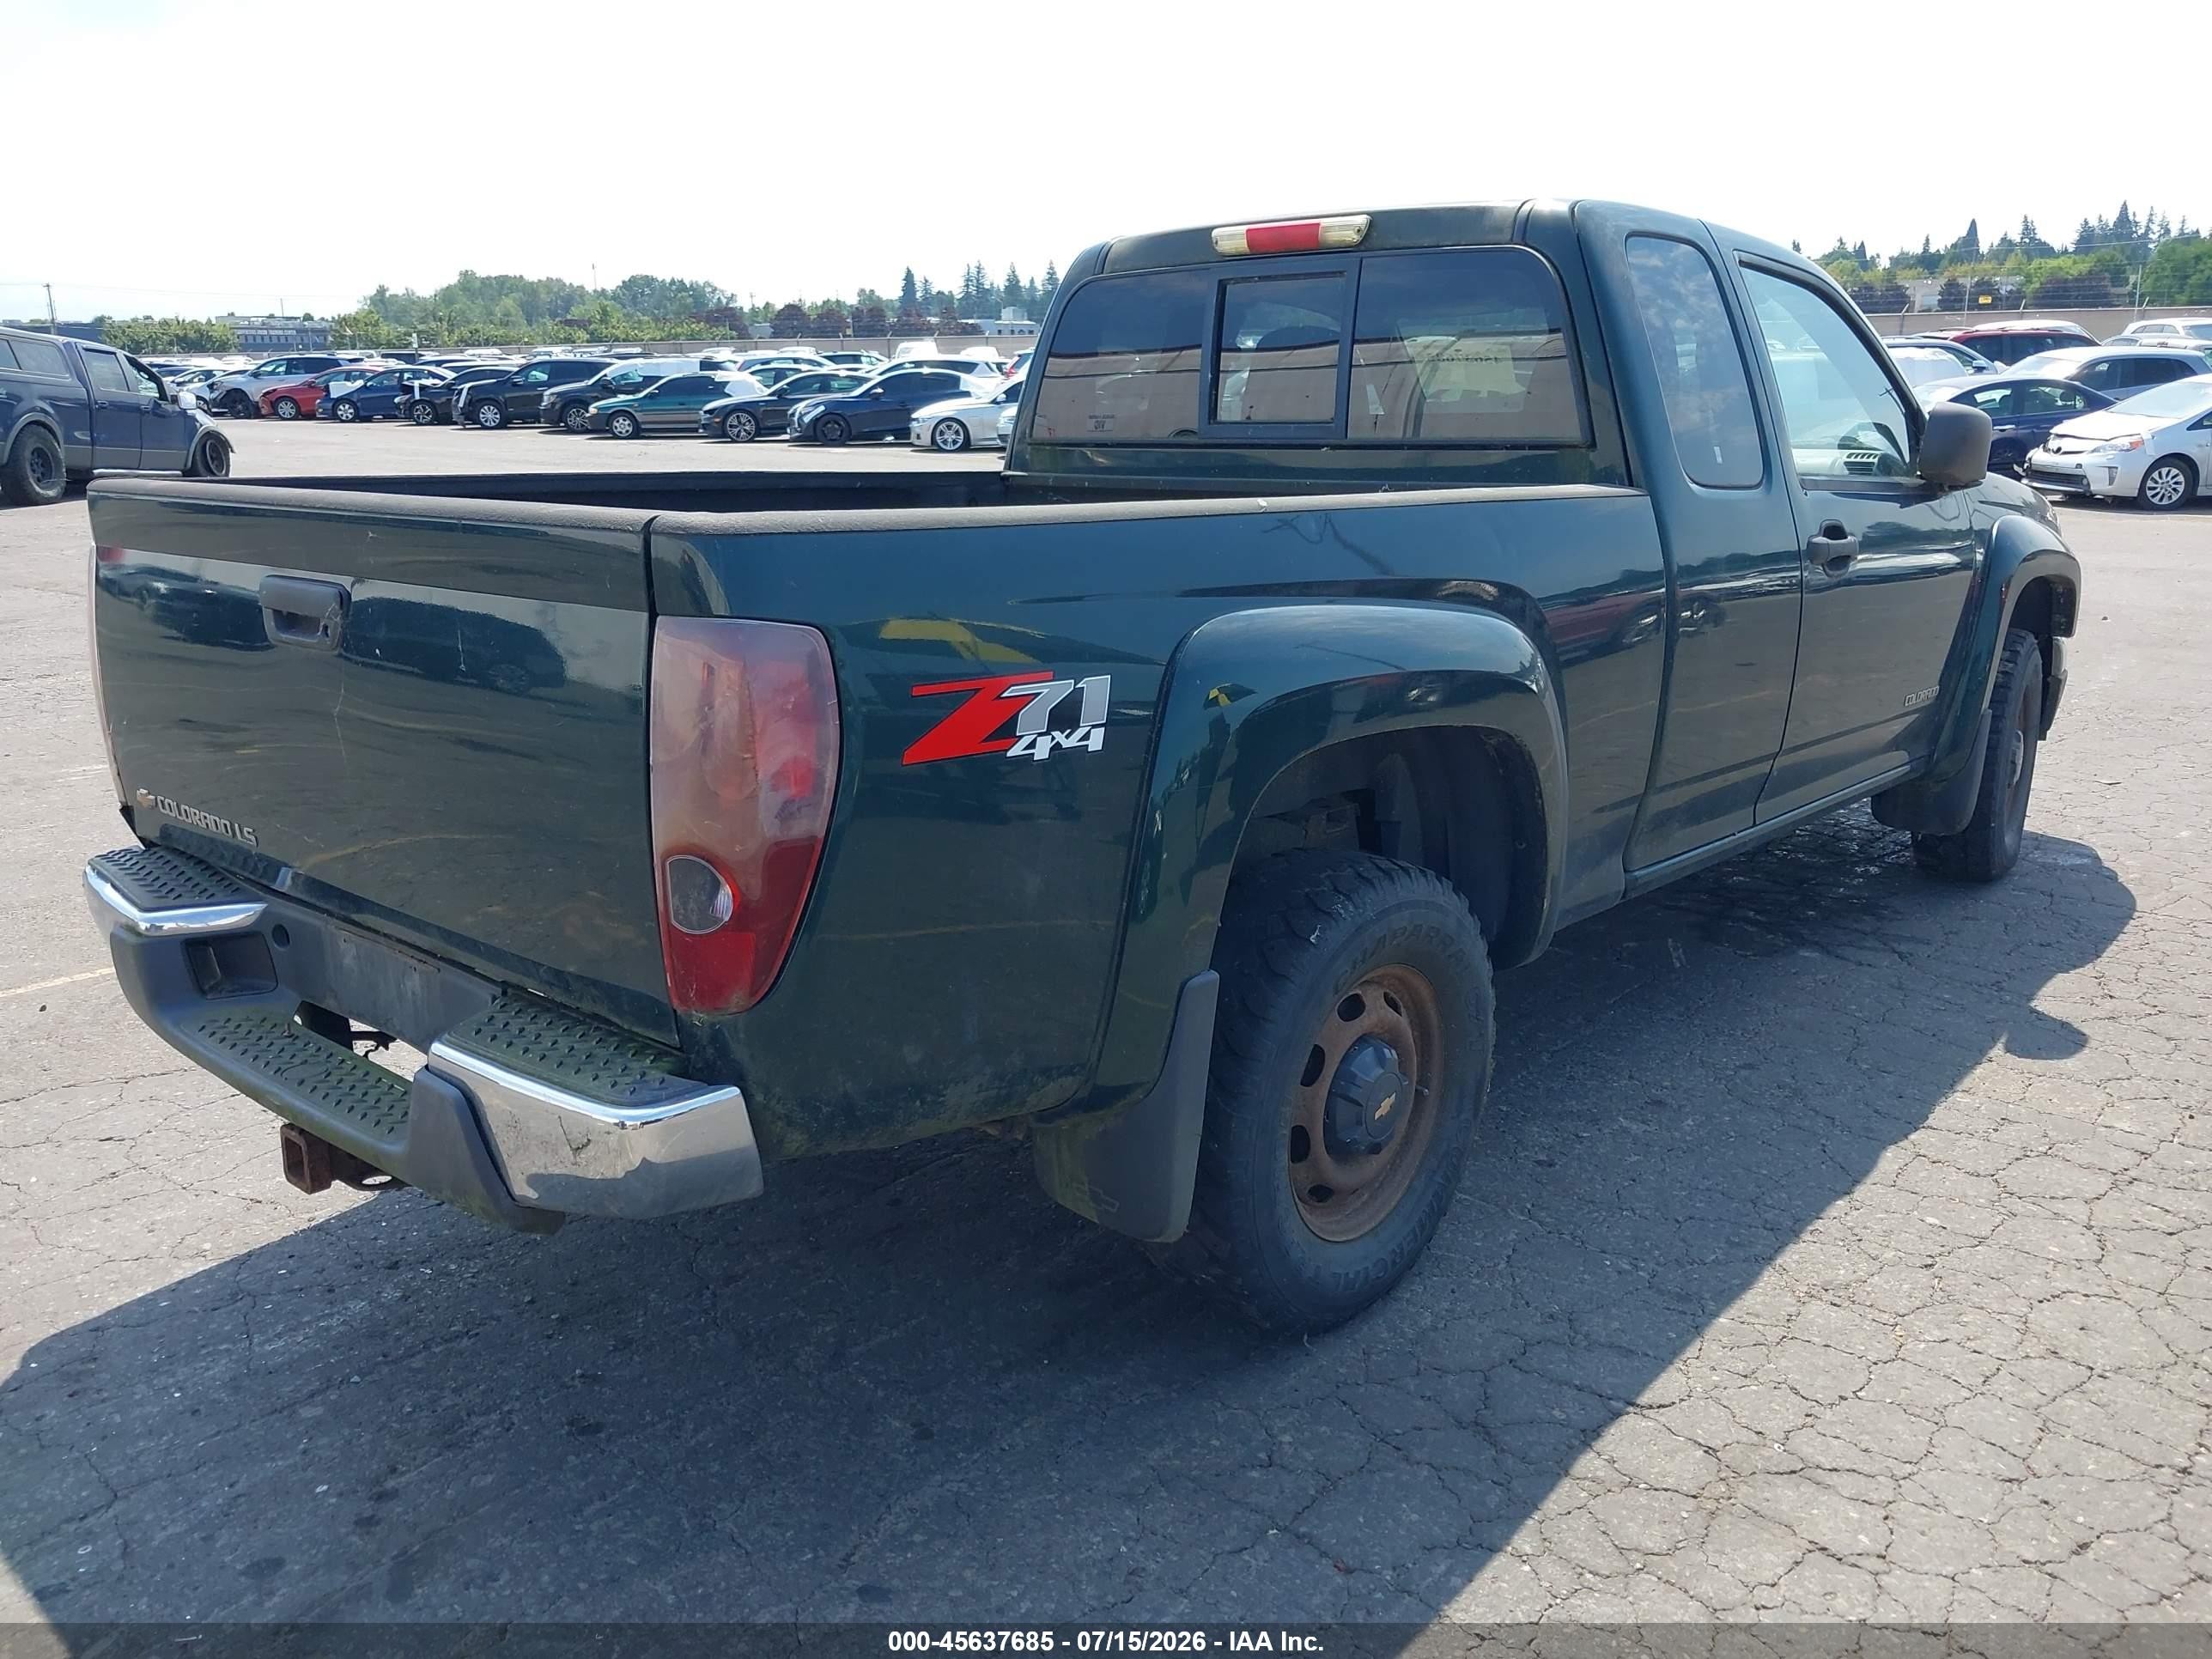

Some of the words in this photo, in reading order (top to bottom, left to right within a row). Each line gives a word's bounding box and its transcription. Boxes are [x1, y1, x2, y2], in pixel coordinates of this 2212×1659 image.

[902, 670, 1112, 766] Z71
[156, 794, 233, 837] COLORADO
[234, 822, 258, 847] LS
